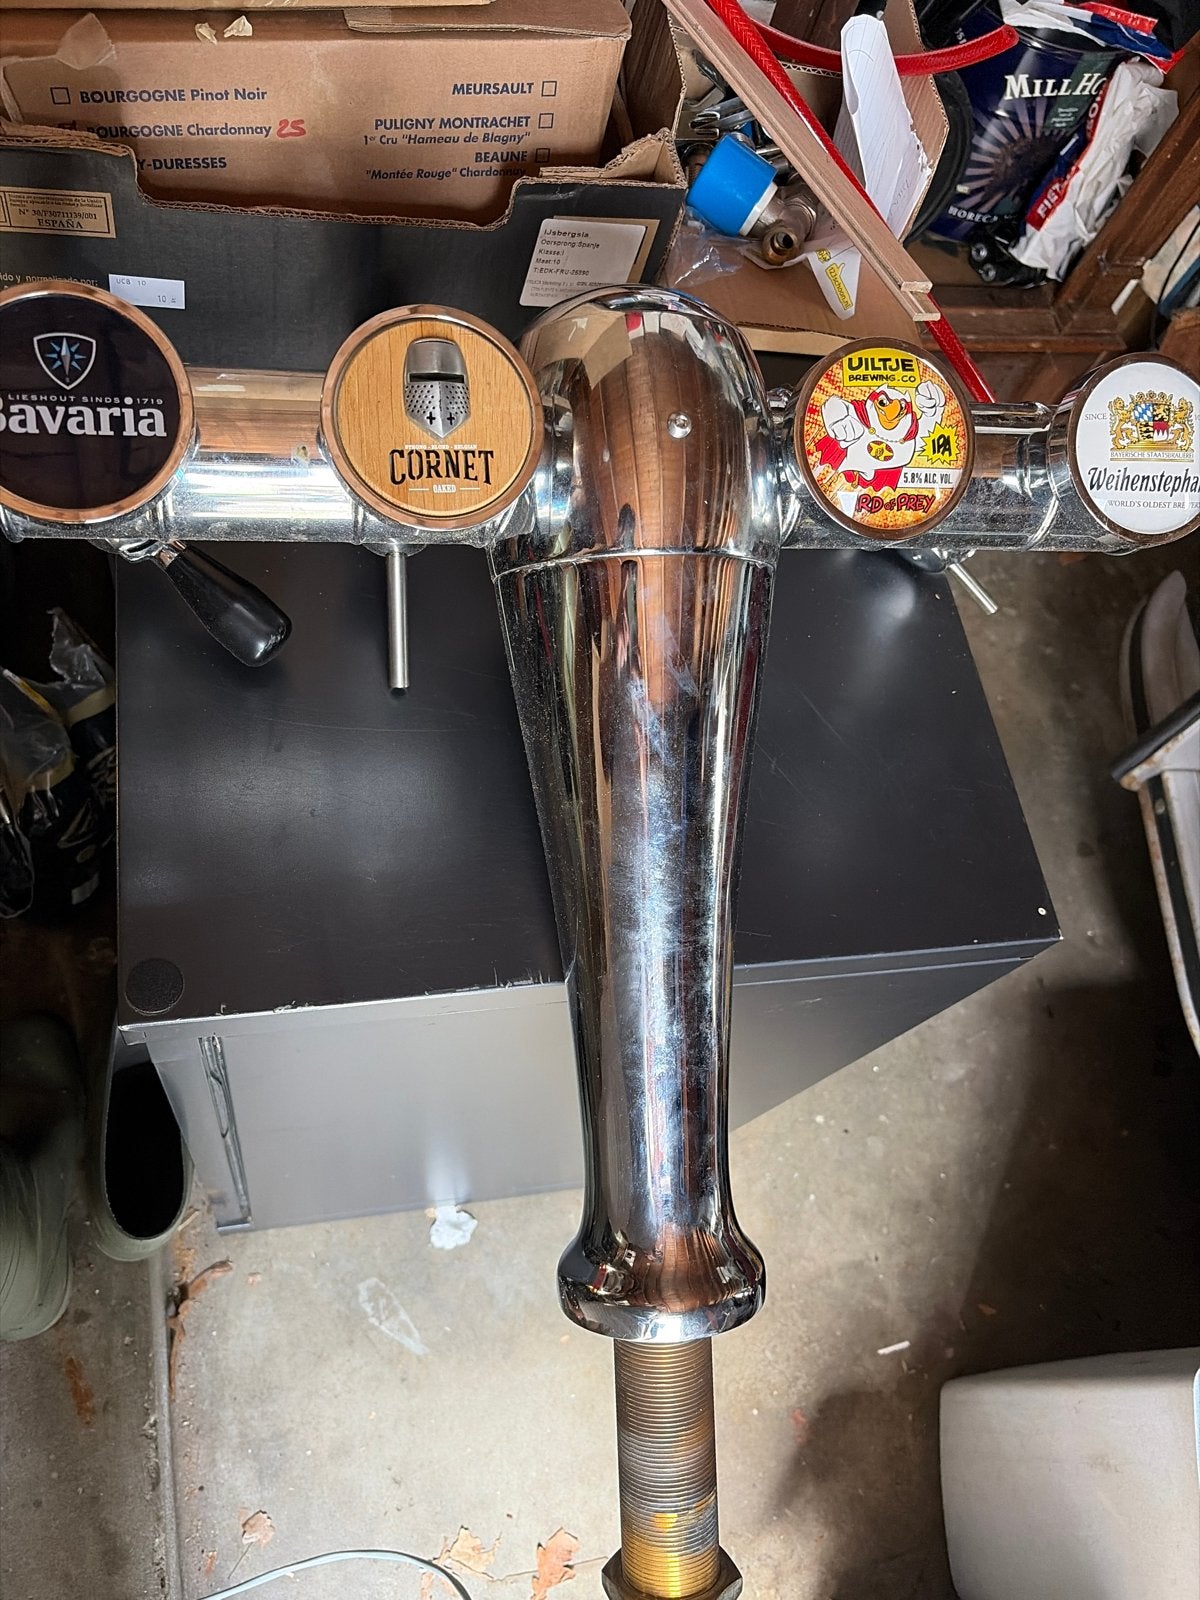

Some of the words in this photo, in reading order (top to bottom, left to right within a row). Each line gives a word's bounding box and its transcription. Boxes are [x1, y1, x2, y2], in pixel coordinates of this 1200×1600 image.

[80, 89, 186, 104] BOURGOGNE
[190, 89, 230, 101] Pinot
[233, 88, 268, 101] Noir
[452, 82, 534, 96] MEURSAULT
[187, 123, 272, 138] Chardonnay
[374, 118, 435, 131] PULIGNY
[439, 116, 531, 130] MONTRACHET
[379, 135, 398, 146] Cru
[402, 133, 460, 146] "Hameau
[463, 132, 479, 144] de
[482, 131, 531, 145] Blagny"
[475, 151, 528, 164] BEAUNE
[366, 168, 414, 180] "Montée
[416, 167, 458, 181] Rouge"
[459, 166, 526, 179] Chardonnay
[37, 218, 84, 229] ESPAÑA
[157, 295, 167, 303] 10
[848, 357, 914, 373] UILTJE
[8, 393, 75, 403] LIESHOUT
[81, 396, 121, 404] SINDS
[136, 397, 163, 405] 1719
[1084, 413, 1108, 421] SINCE
[931, 434, 953, 457] IPA
[389, 449, 494, 486] CORNET
[903, 472, 922, 484] 5.8%
[924, 472, 938, 485] ALC.
[940, 472, 953, 485] VOL.
[857, 494, 883, 514] RD
[896, 493, 936, 514] PREY
[1108, 500, 1142, 508] WORLD'S
[1143, 501, 1172, 509] OLDEST
